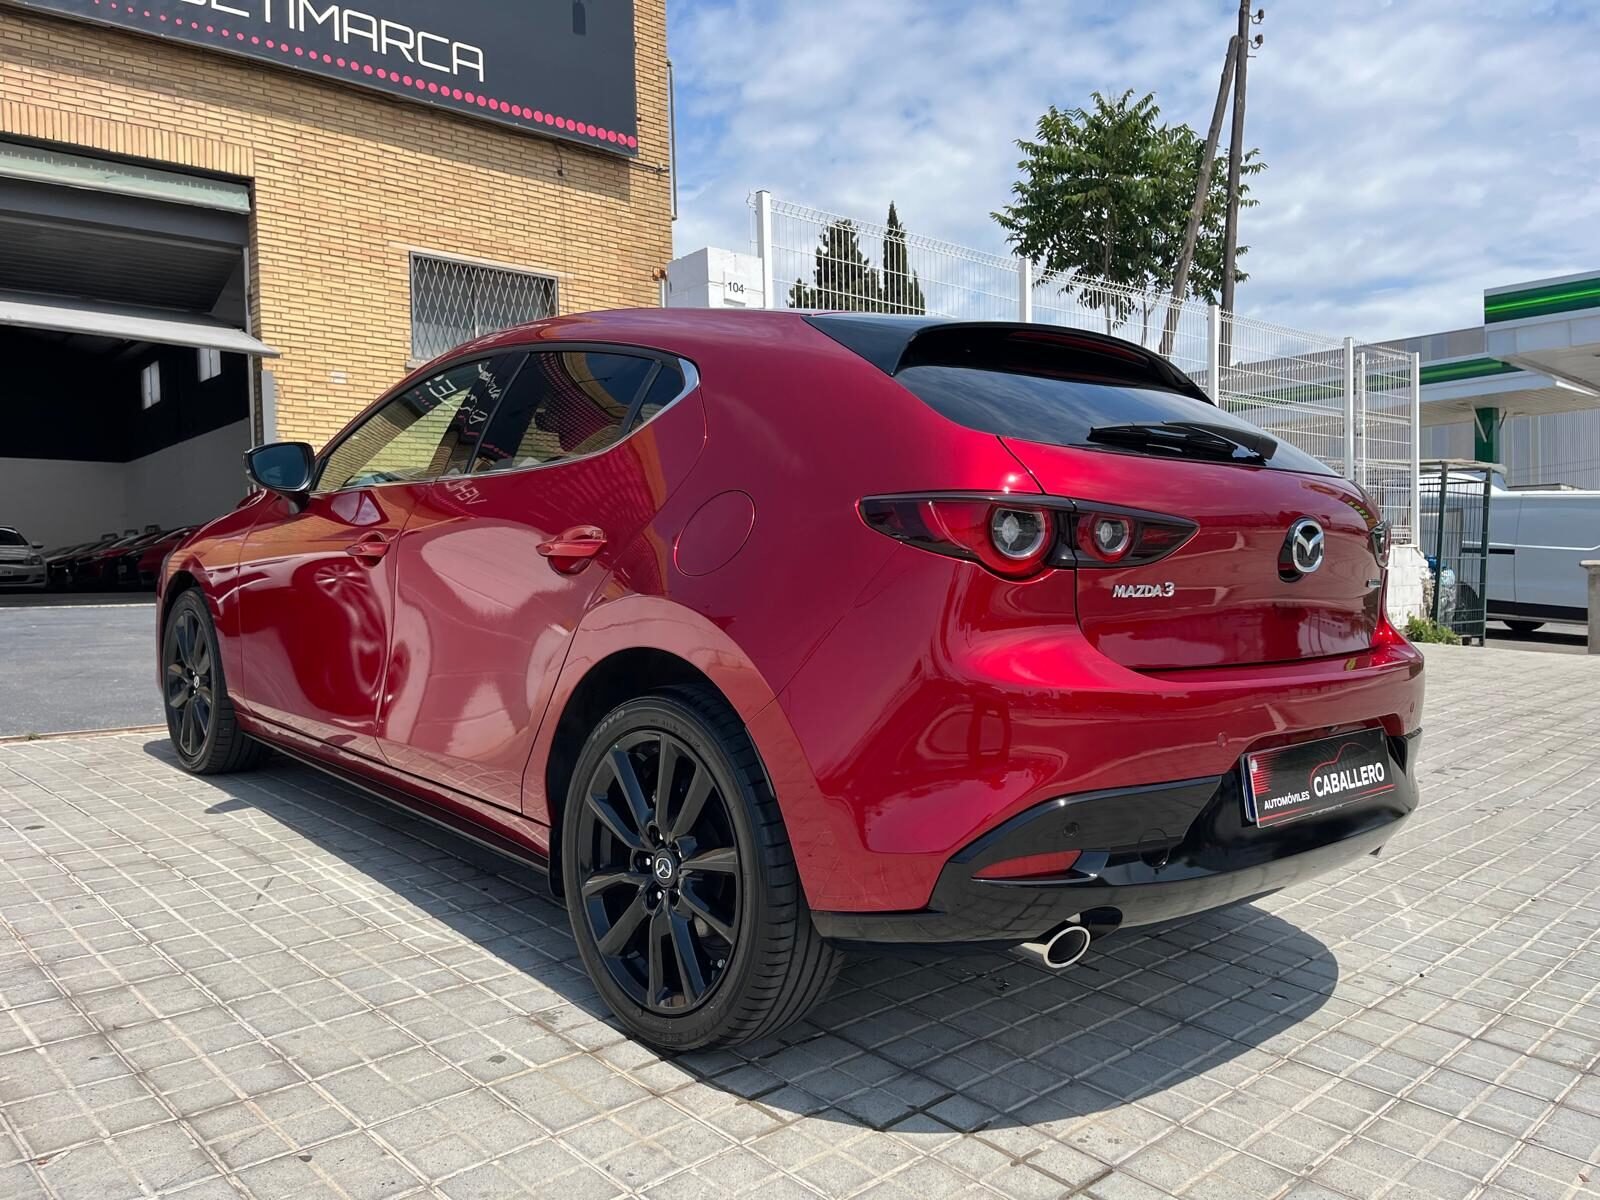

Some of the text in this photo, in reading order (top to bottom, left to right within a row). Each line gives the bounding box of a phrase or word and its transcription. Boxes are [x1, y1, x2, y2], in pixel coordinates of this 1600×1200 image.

[727, 281, 745, 295] 104
[1264, 790, 1310, 810] AUTOMÓVILES
[1313, 762, 1386, 797] CABALLERO
